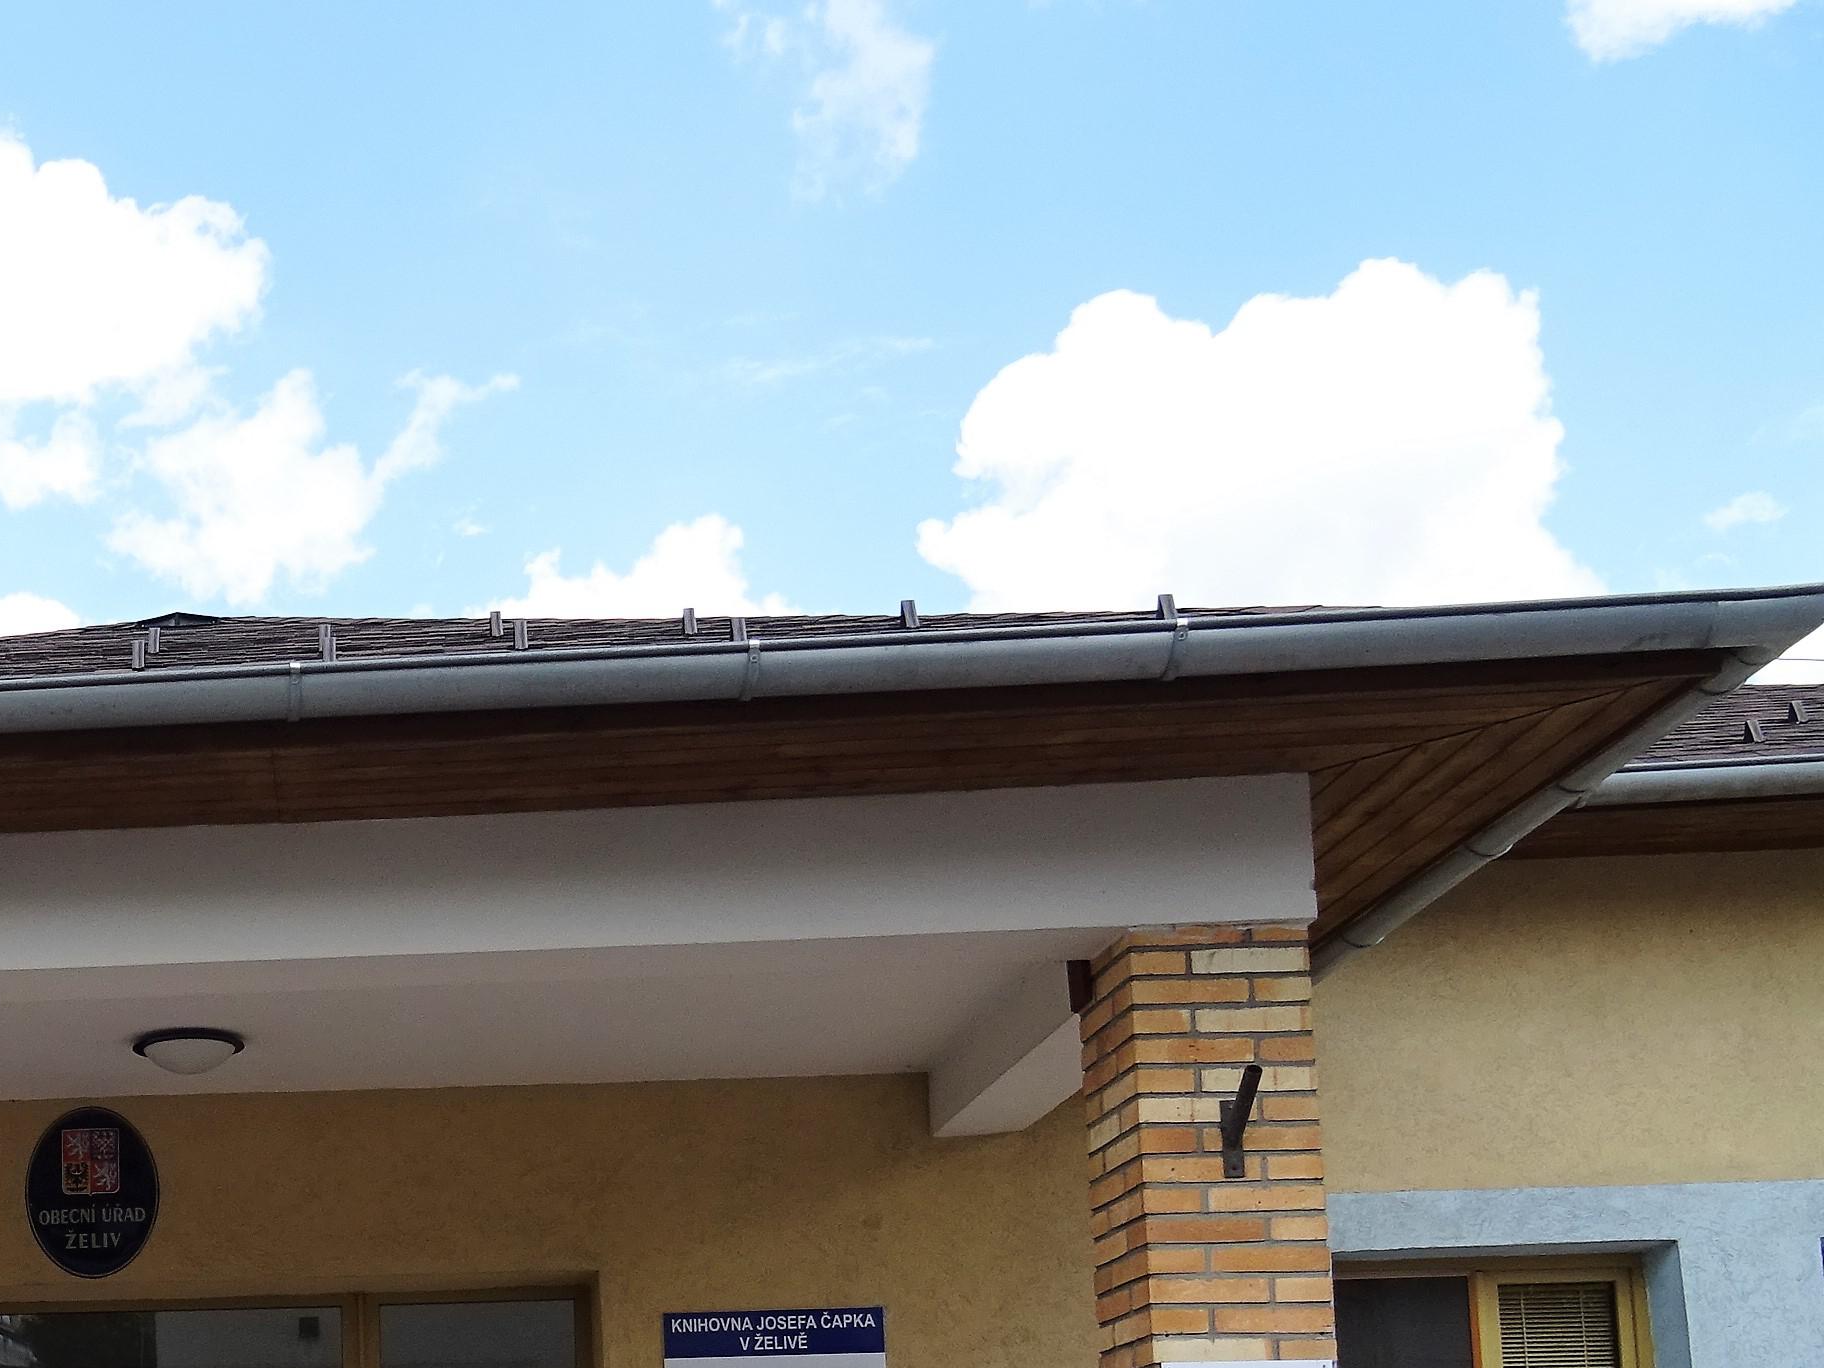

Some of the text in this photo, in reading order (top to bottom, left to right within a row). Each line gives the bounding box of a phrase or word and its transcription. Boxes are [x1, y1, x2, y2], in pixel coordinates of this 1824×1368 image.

[39, 1203, 146, 1225] OBECNÍ ÚŘAD
[65, 1229, 121, 1249] ŽELIV
[671, 1312, 876, 1333] KNIHOVNA JOSEFA ČAPKA
[739, 1332, 808, 1351] V ŽELIVĚ
